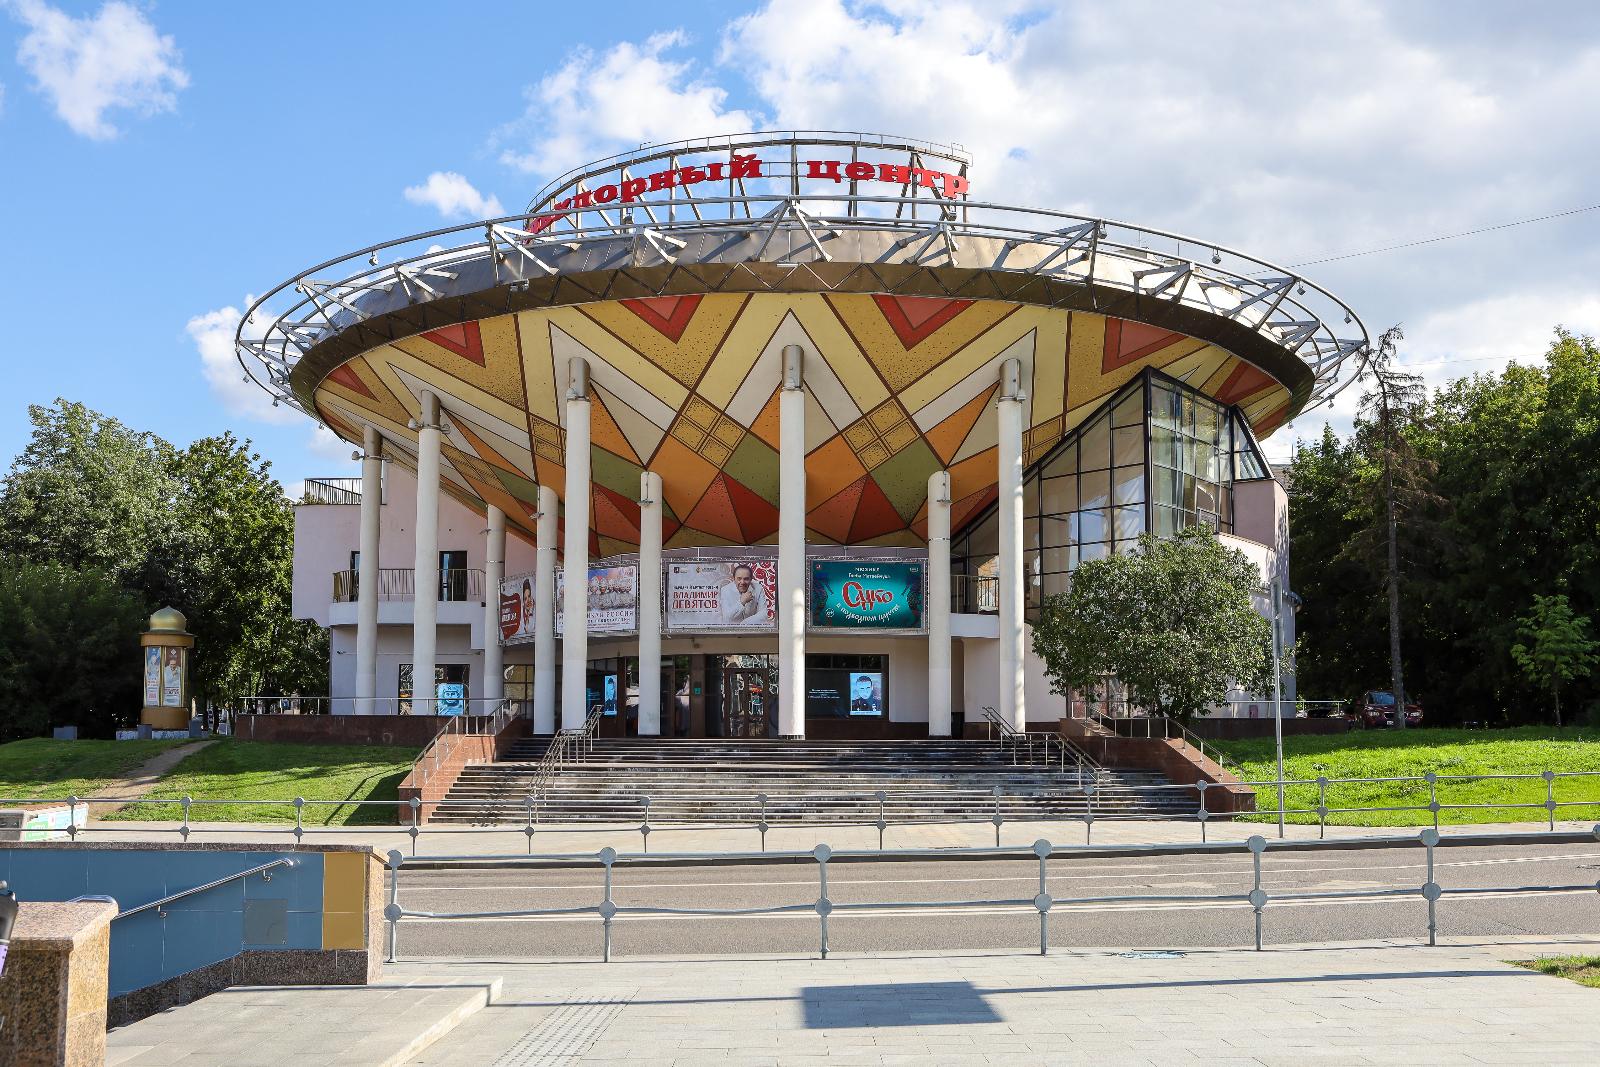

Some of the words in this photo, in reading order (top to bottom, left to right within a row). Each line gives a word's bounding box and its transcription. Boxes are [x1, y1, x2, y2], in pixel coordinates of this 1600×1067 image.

[806, 160, 970, 197] центр
[673, 591, 719, 599] ВЛАДИМИР
[672, 599, 718, 609] ДЕВЯТОВ
